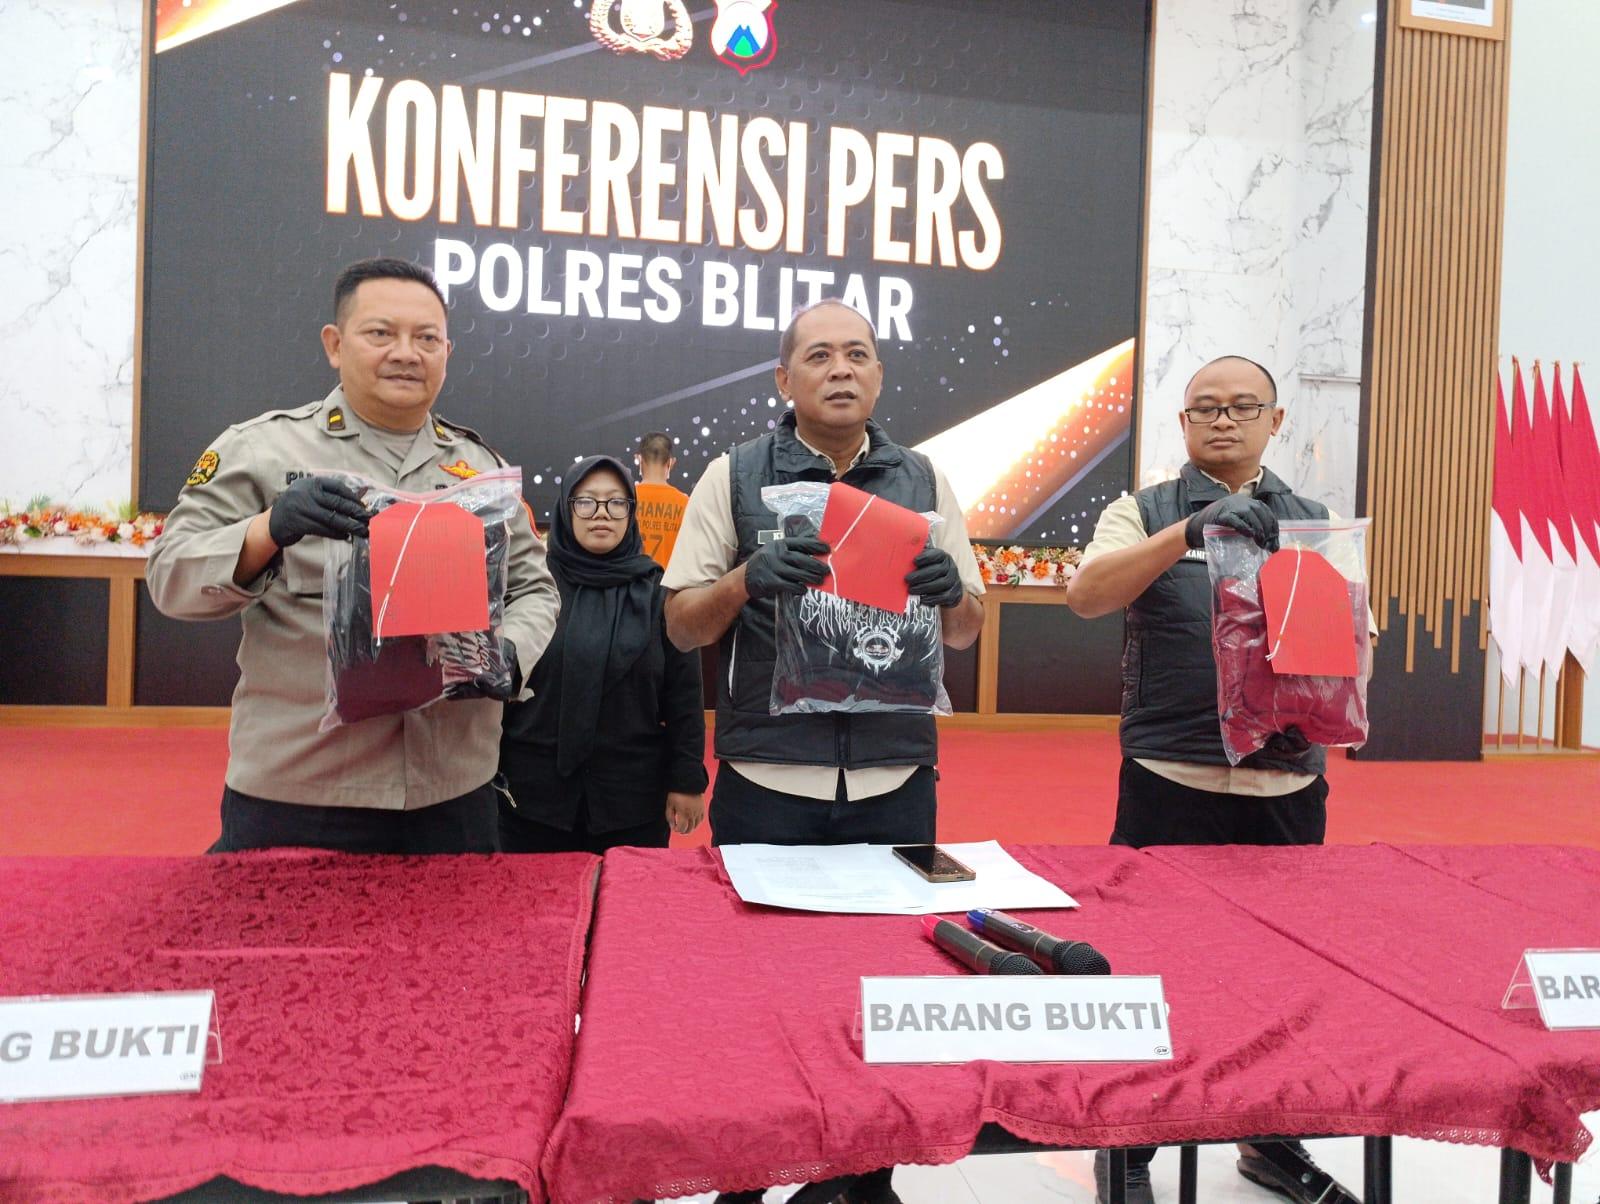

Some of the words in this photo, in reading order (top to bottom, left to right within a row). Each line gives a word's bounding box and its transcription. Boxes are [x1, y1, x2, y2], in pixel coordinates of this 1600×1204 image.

[326, 72, 808, 254] KONFERENSI
[826, 125, 1005, 271] PERS
[434, 238, 683, 323] POLRES
[701, 260, 913, 342] BLITAR
[49, 1024, 200, 1061] BUKTI
[869, 1002, 1032, 1032] BARANG
[1044, 1001, 1162, 1030] BUKTI
